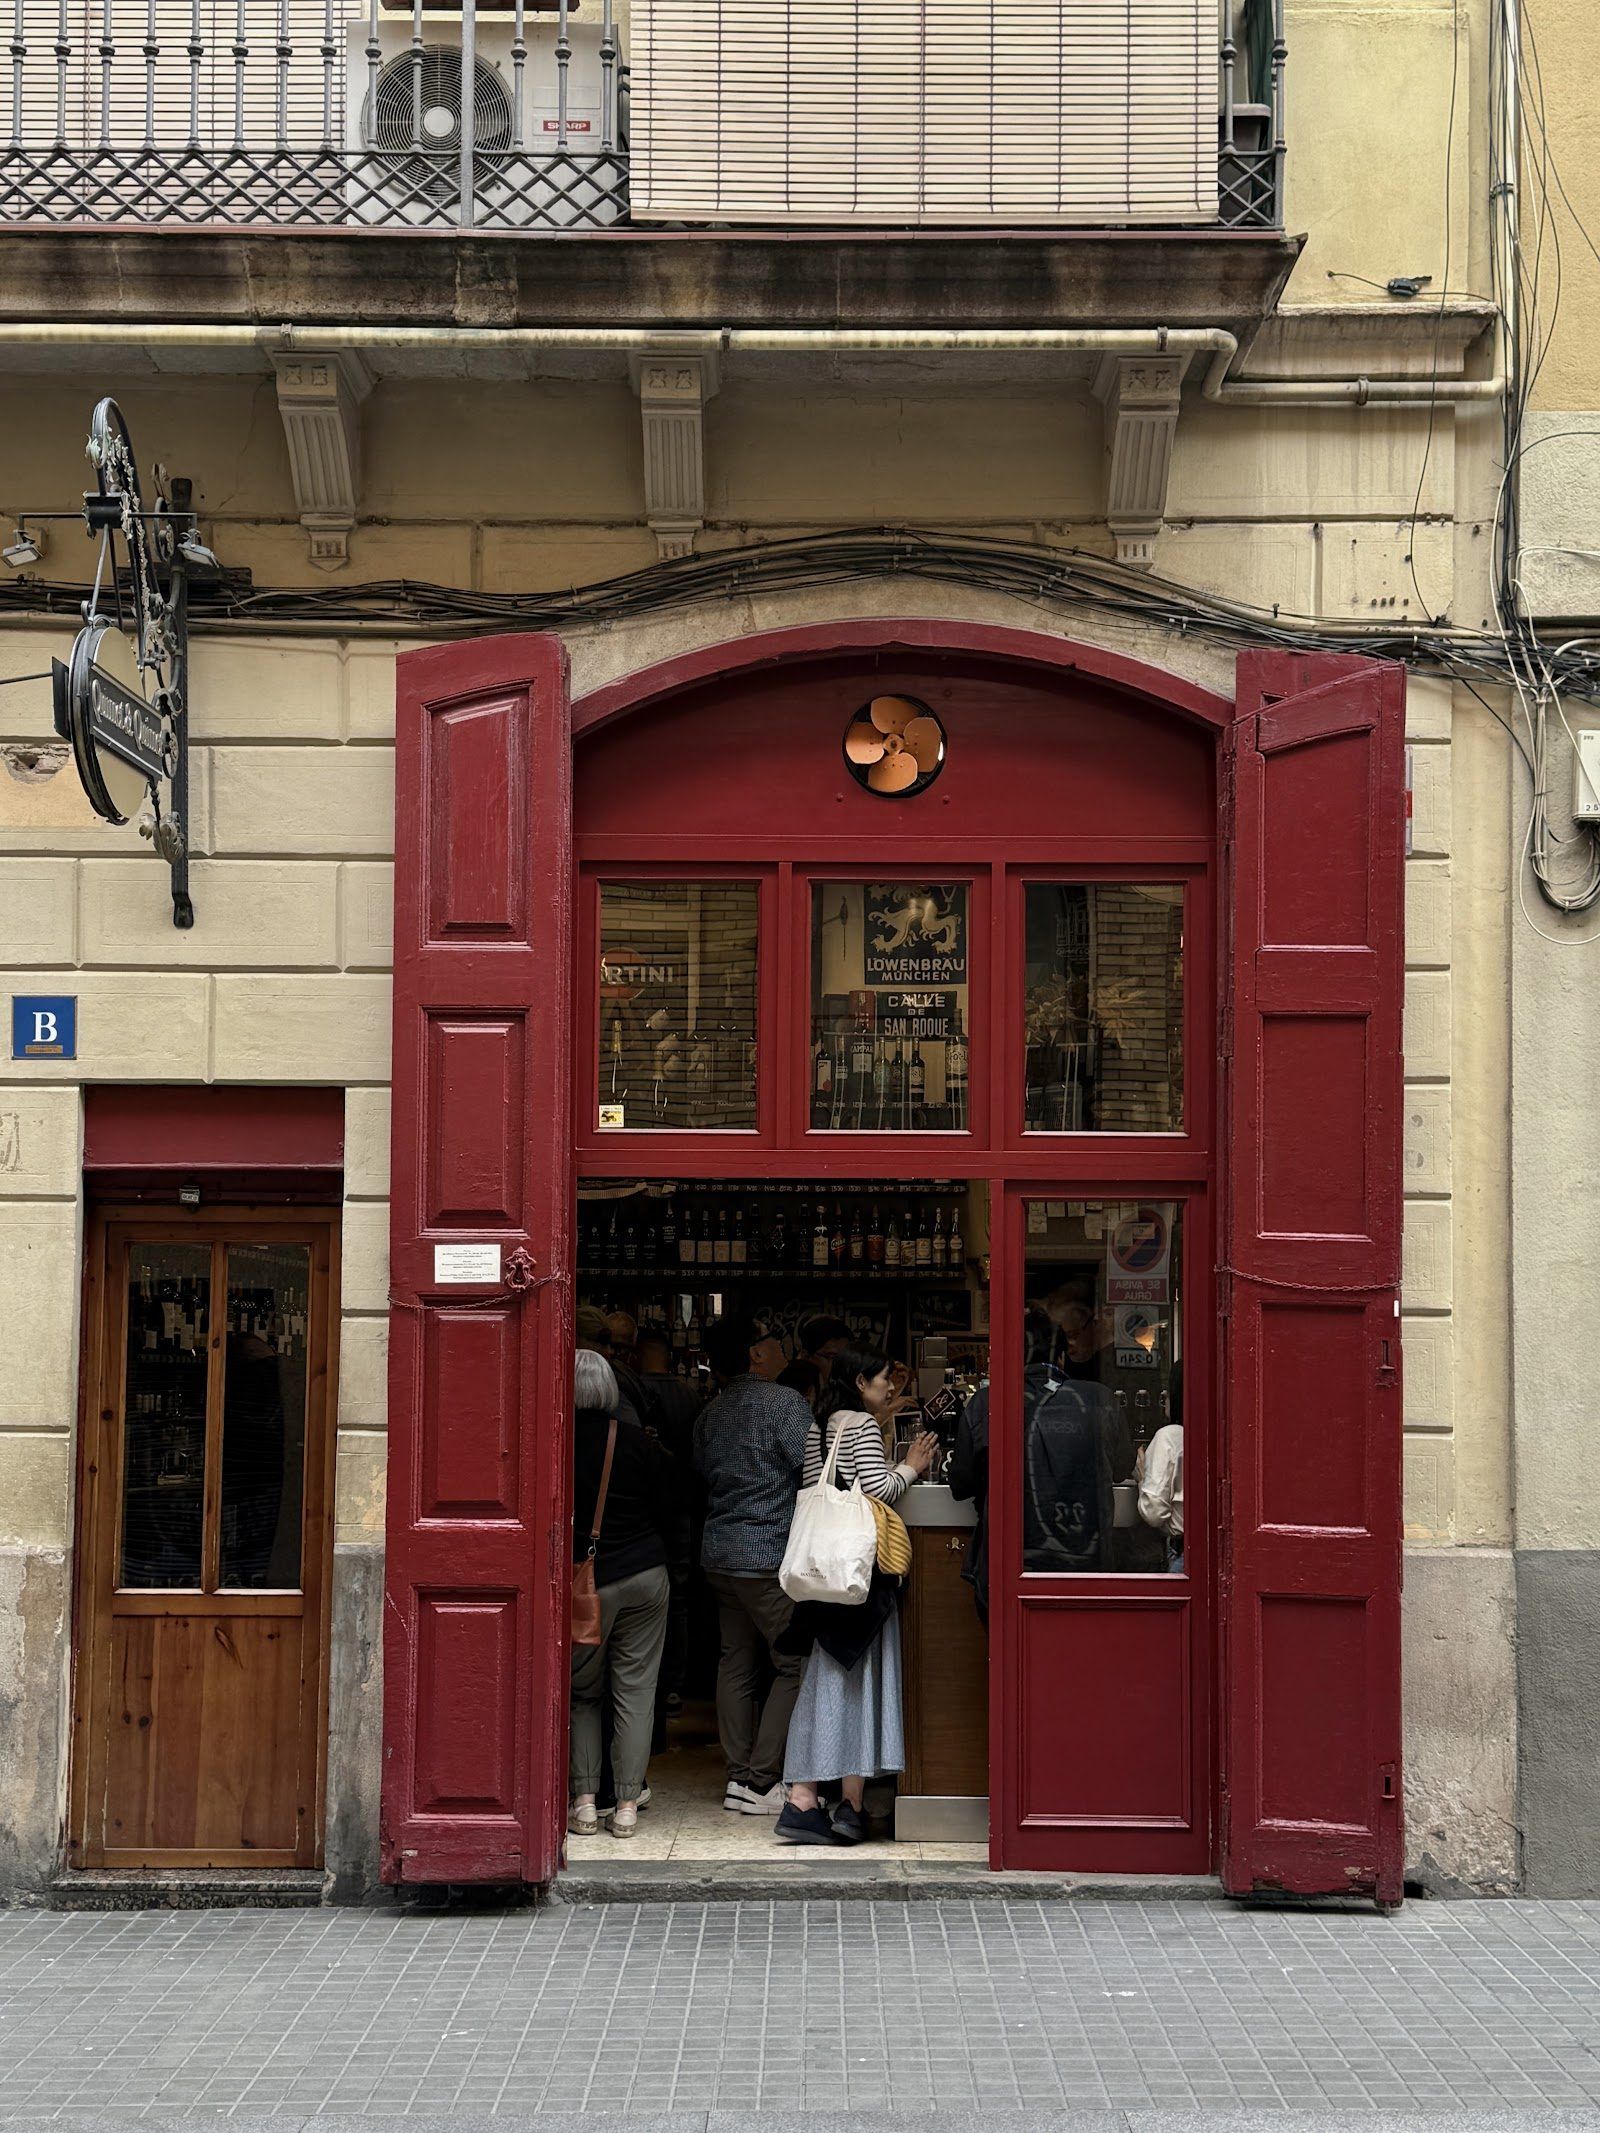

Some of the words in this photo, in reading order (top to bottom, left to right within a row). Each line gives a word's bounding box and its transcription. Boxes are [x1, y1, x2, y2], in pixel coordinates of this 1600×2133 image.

[867, 957, 965, 971] LÖWENBRÄU
[881, 970, 950, 981] MÜNCHEN
[907, 1008, 925, 1016] DE
[32, 1011, 58, 1042] B
[884, 1017, 907, 1036] SAN
[912, 1017, 949, 1037] ROQUE
